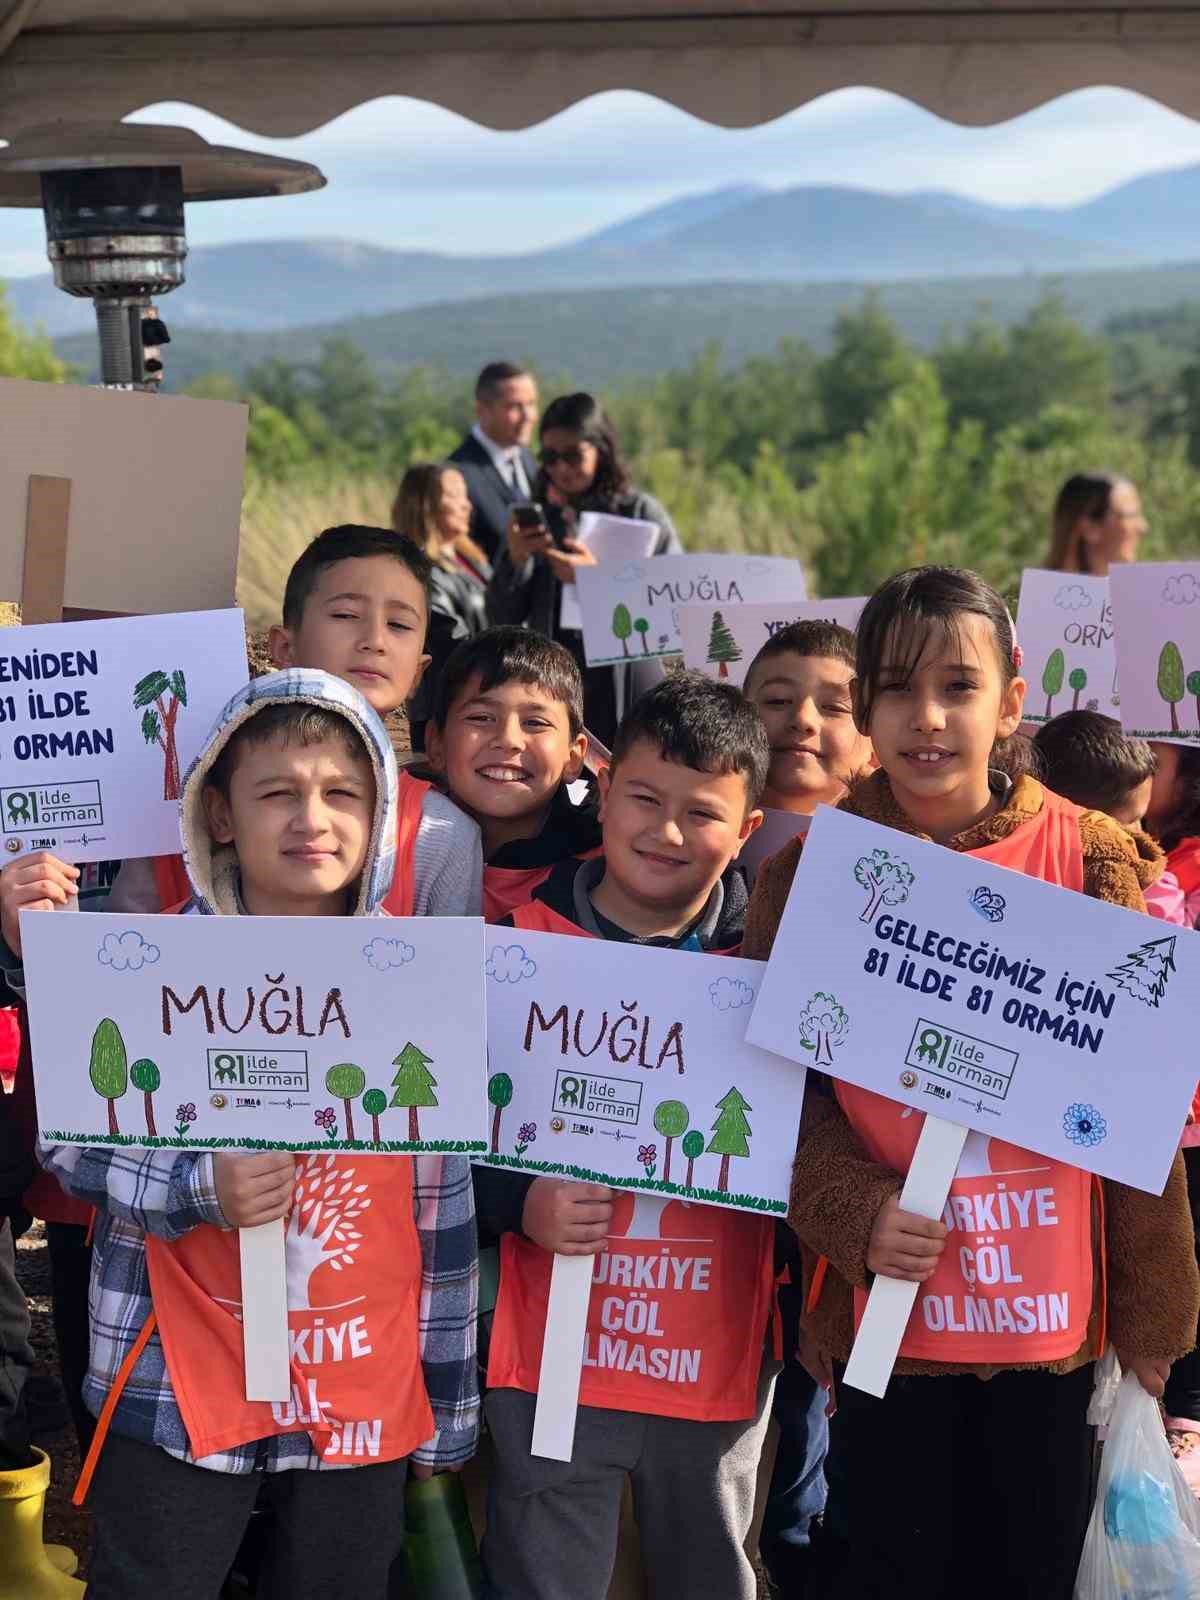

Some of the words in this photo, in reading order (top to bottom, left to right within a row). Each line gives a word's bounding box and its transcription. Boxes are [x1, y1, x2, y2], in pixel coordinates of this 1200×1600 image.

[647, 574, 743, 606] MUĞLA
[0, 648, 98, 682] ENİDEN
[28, 688, 91, 720] İLDE
[14, 728, 114, 760] ORMAN
[40, 789, 71, 806] ilde
[41, 808, 97, 823] orman
[875, 914, 1046, 995] GELECEĞİMİZ
[1055, 971, 1115, 1019] İÇİN
[161, 972, 352, 1038] MUĞLA
[863, 947, 889, 977] 81
[896, 953, 957, 1002] İLDE
[966, 985, 994, 1015] 81
[1002, 998, 1104, 1053] ORMAN
[523, 1000, 686, 1075] MUĞLA
[952, 1039, 985, 1063] ilde
[247, 1055, 278, 1069] ilde
[946, 1061, 1004, 1091] orman
[248, 1075, 303, 1086] orman
[588, 1080, 616, 1098] ilde
[586, 1101, 634, 1118] orman
[959, 1236, 1023, 1293] ÇÖL
[601, 1291, 664, 1337] ÇÖL
[922, 1292, 1069, 1335] OLMASIN
[289, 1315, 372, 1365] KİYE
[582, 1332, 702, 1383] LMASIN
